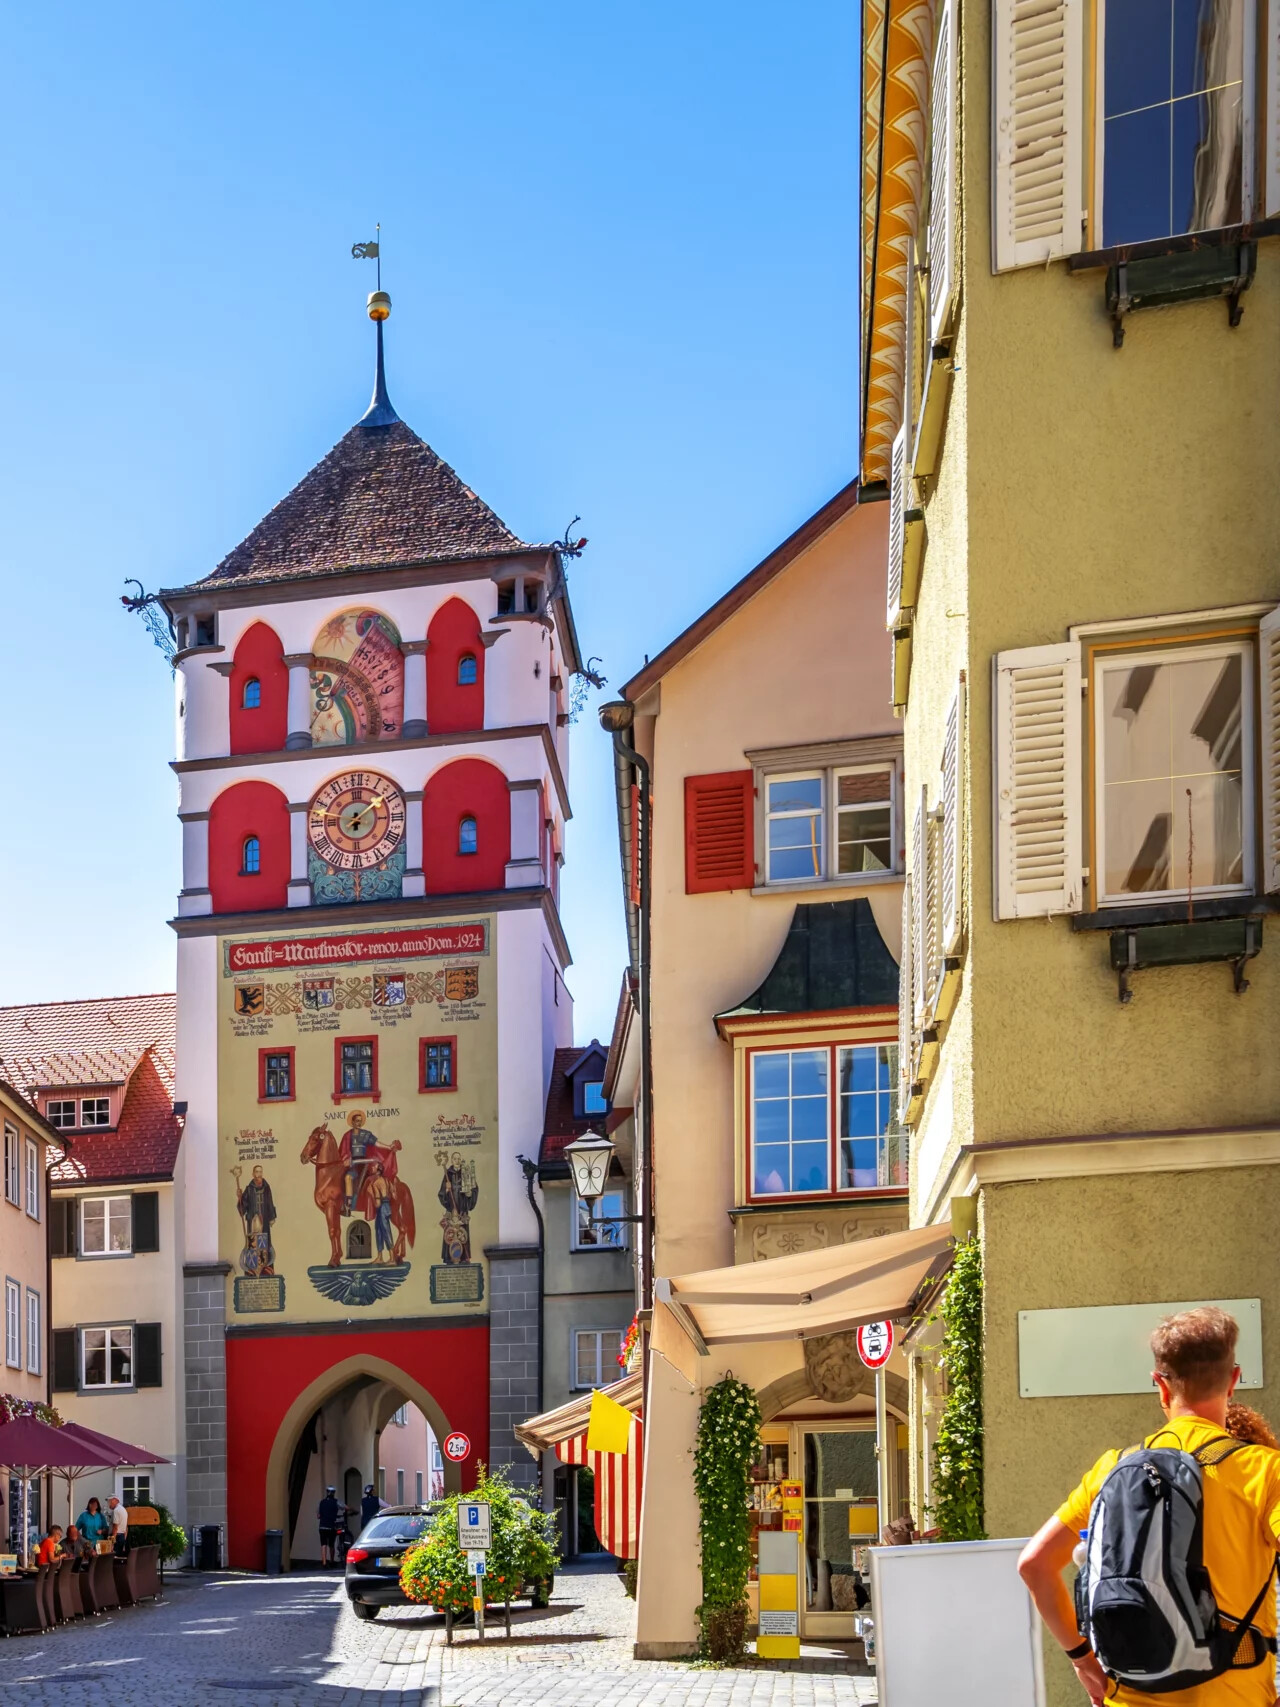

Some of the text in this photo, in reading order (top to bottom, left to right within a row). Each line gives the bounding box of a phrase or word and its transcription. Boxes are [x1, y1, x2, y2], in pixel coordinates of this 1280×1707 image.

[456, 933, 482, 948] 1924
[324, 1111, 347, 1121] SANCT
[470, 1511, 477, 1523] P
